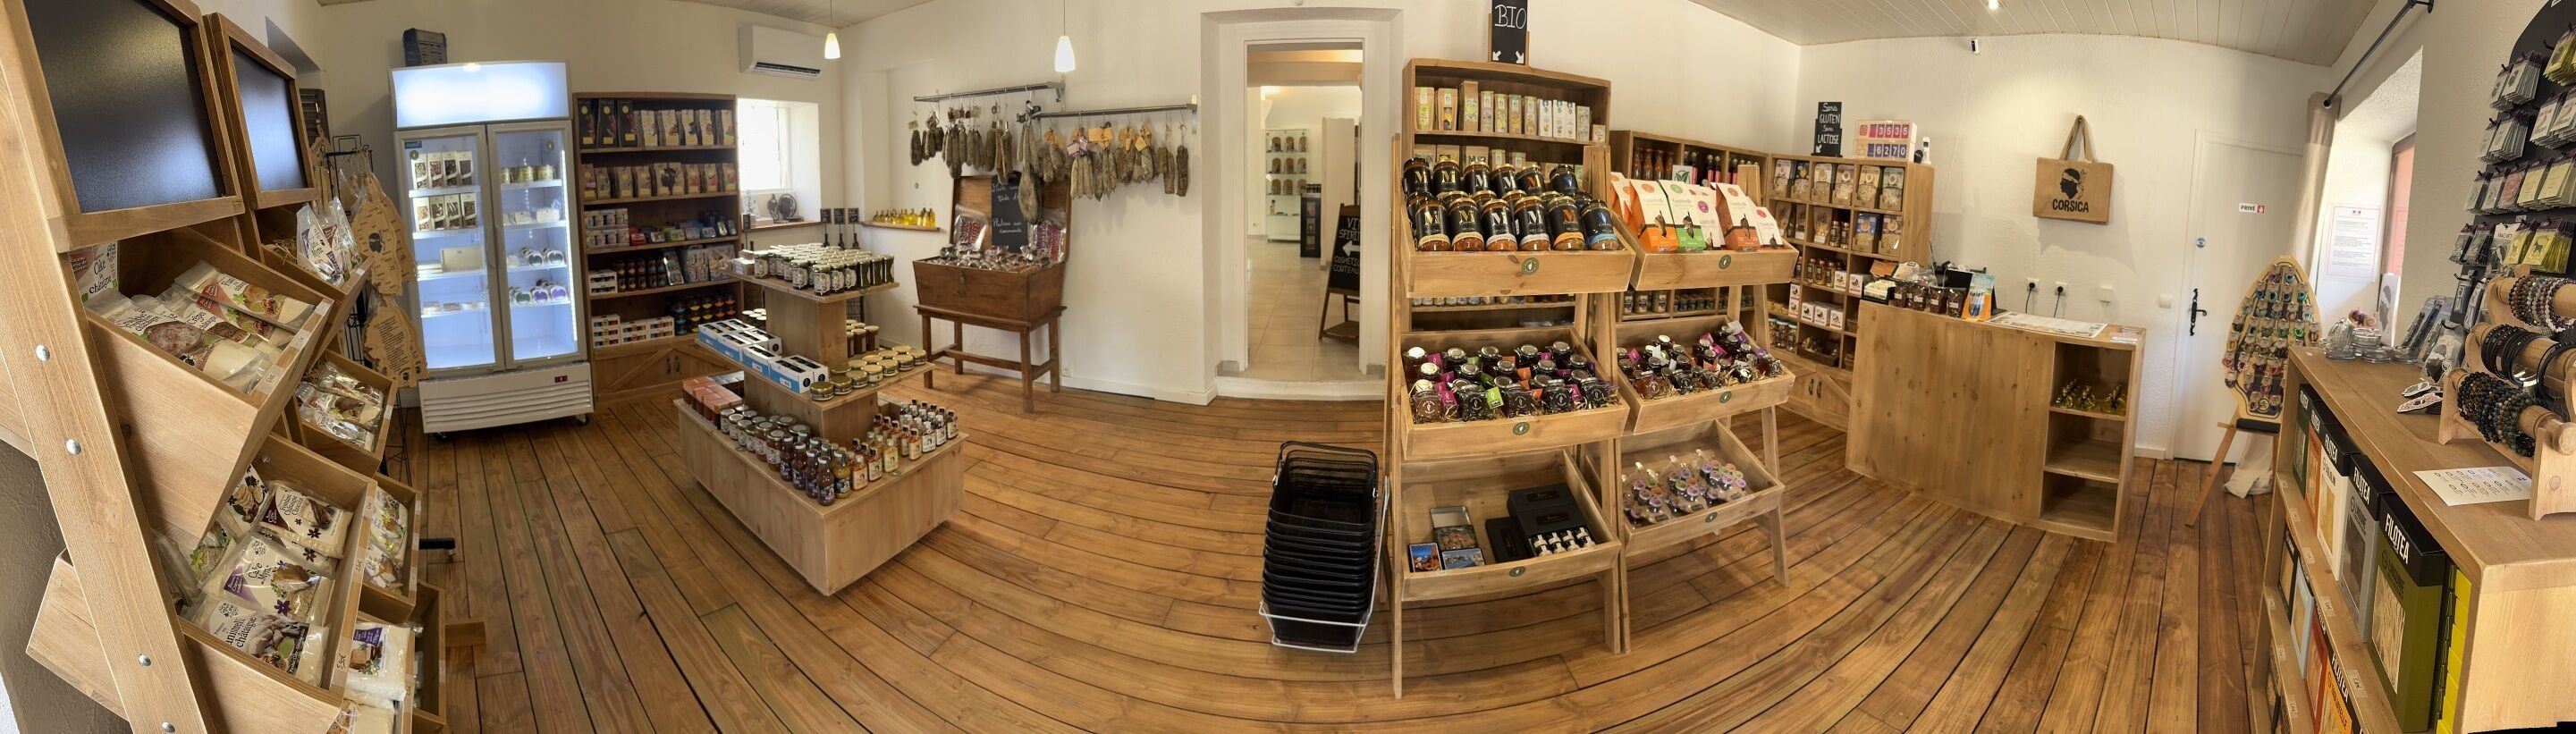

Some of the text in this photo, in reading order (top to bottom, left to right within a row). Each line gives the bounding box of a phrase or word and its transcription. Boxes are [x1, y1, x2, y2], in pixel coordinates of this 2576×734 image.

[1494, 4, 1527, 30] BIO
[1819, 114, 1840, 124] GLUTEN
[1879, 126, 1908, 136] 3535
[1817, 134, 1839, 145] LACTOSE
[1876, 146, 1905, 156] 6270
[2052, 198, 2090, 213] CORSICA
[2324, 434, 2338, 464] FILOTEA
[2353, 466, 2371, 505] FILOTEA
[2385, 512, 2410, 564] FILOTEA
[248, 562, 263, 579] Cake
